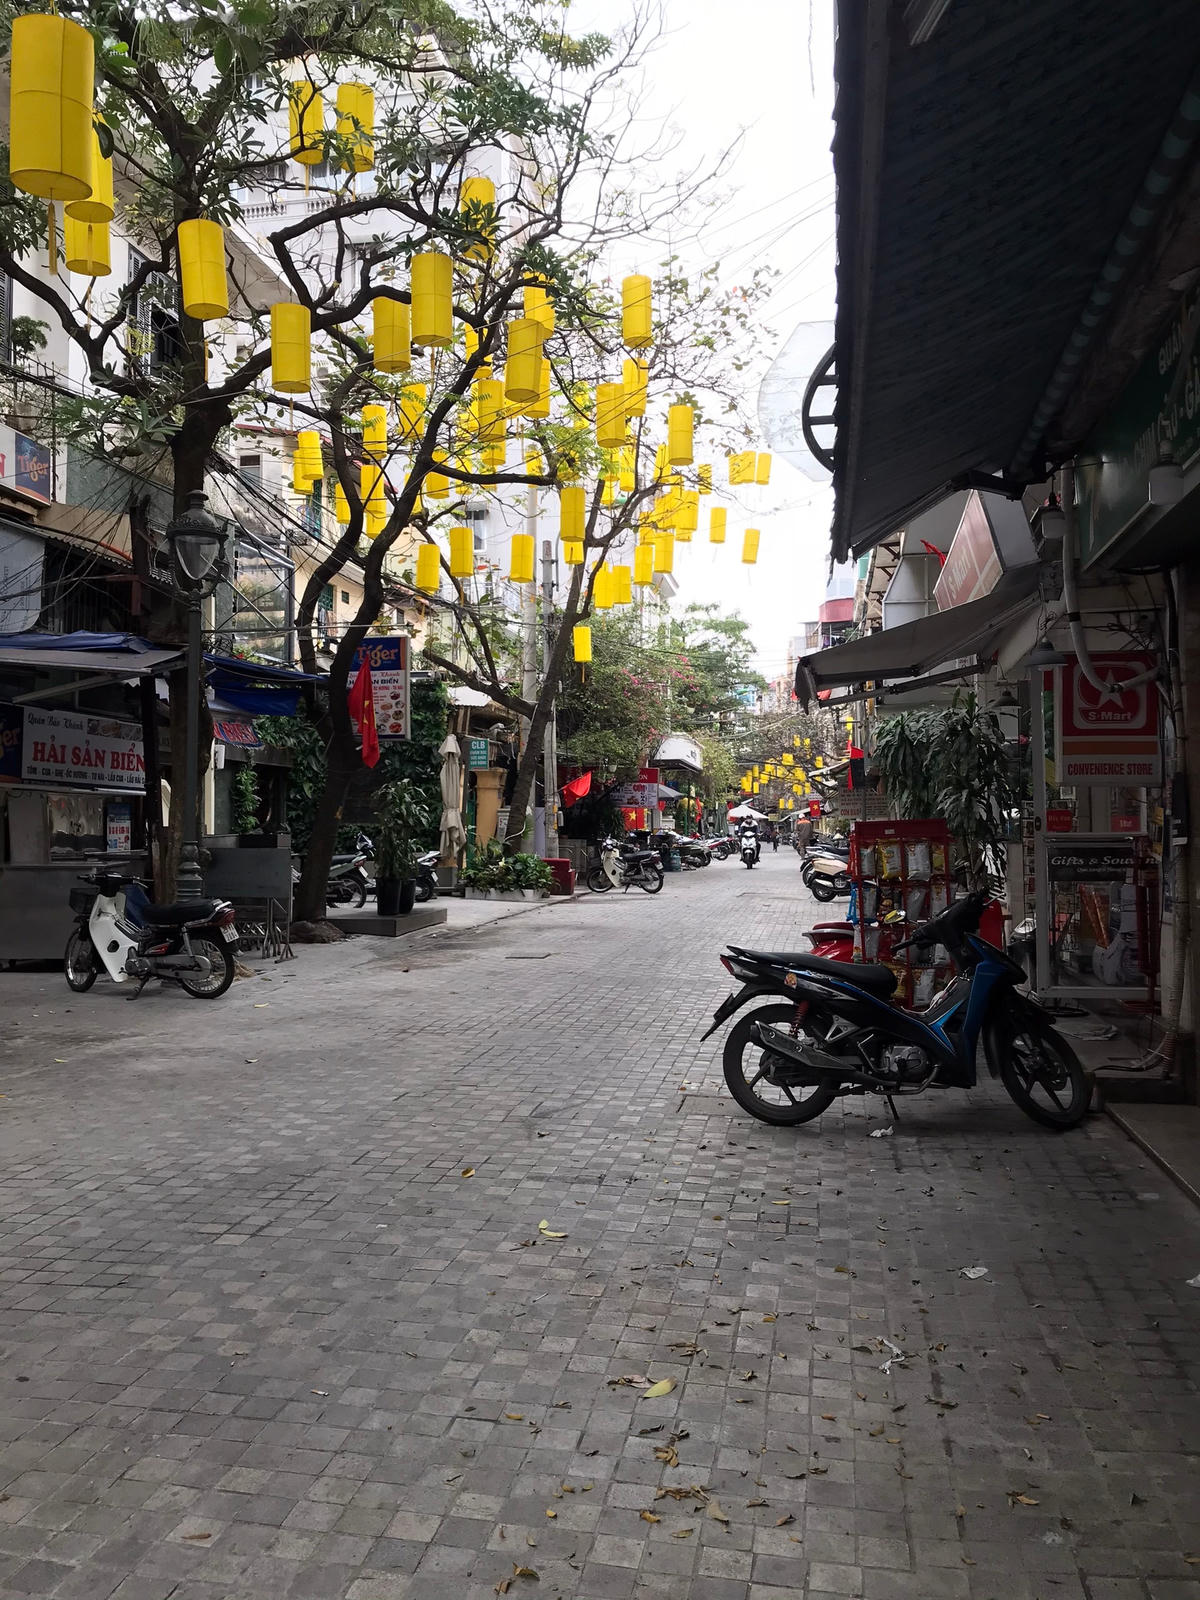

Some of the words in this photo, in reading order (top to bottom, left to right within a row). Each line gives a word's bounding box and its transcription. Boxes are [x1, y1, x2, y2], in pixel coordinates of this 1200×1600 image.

[17, 455, 49, 482] Tiger
[356, 643, 399, 667] Tiger
[32, 735, 67, 764] HẢI
[71, 739, 106, 769] SẢN
[110, 742, 146, 773] BIỂN
[471, 740, 486, 750] CLB
[1067, 762, 1125, 776] CONVENIENCE
[1126, 762, 1153, 776] STORE
[1051, 856, 1084, 867] Gifts
